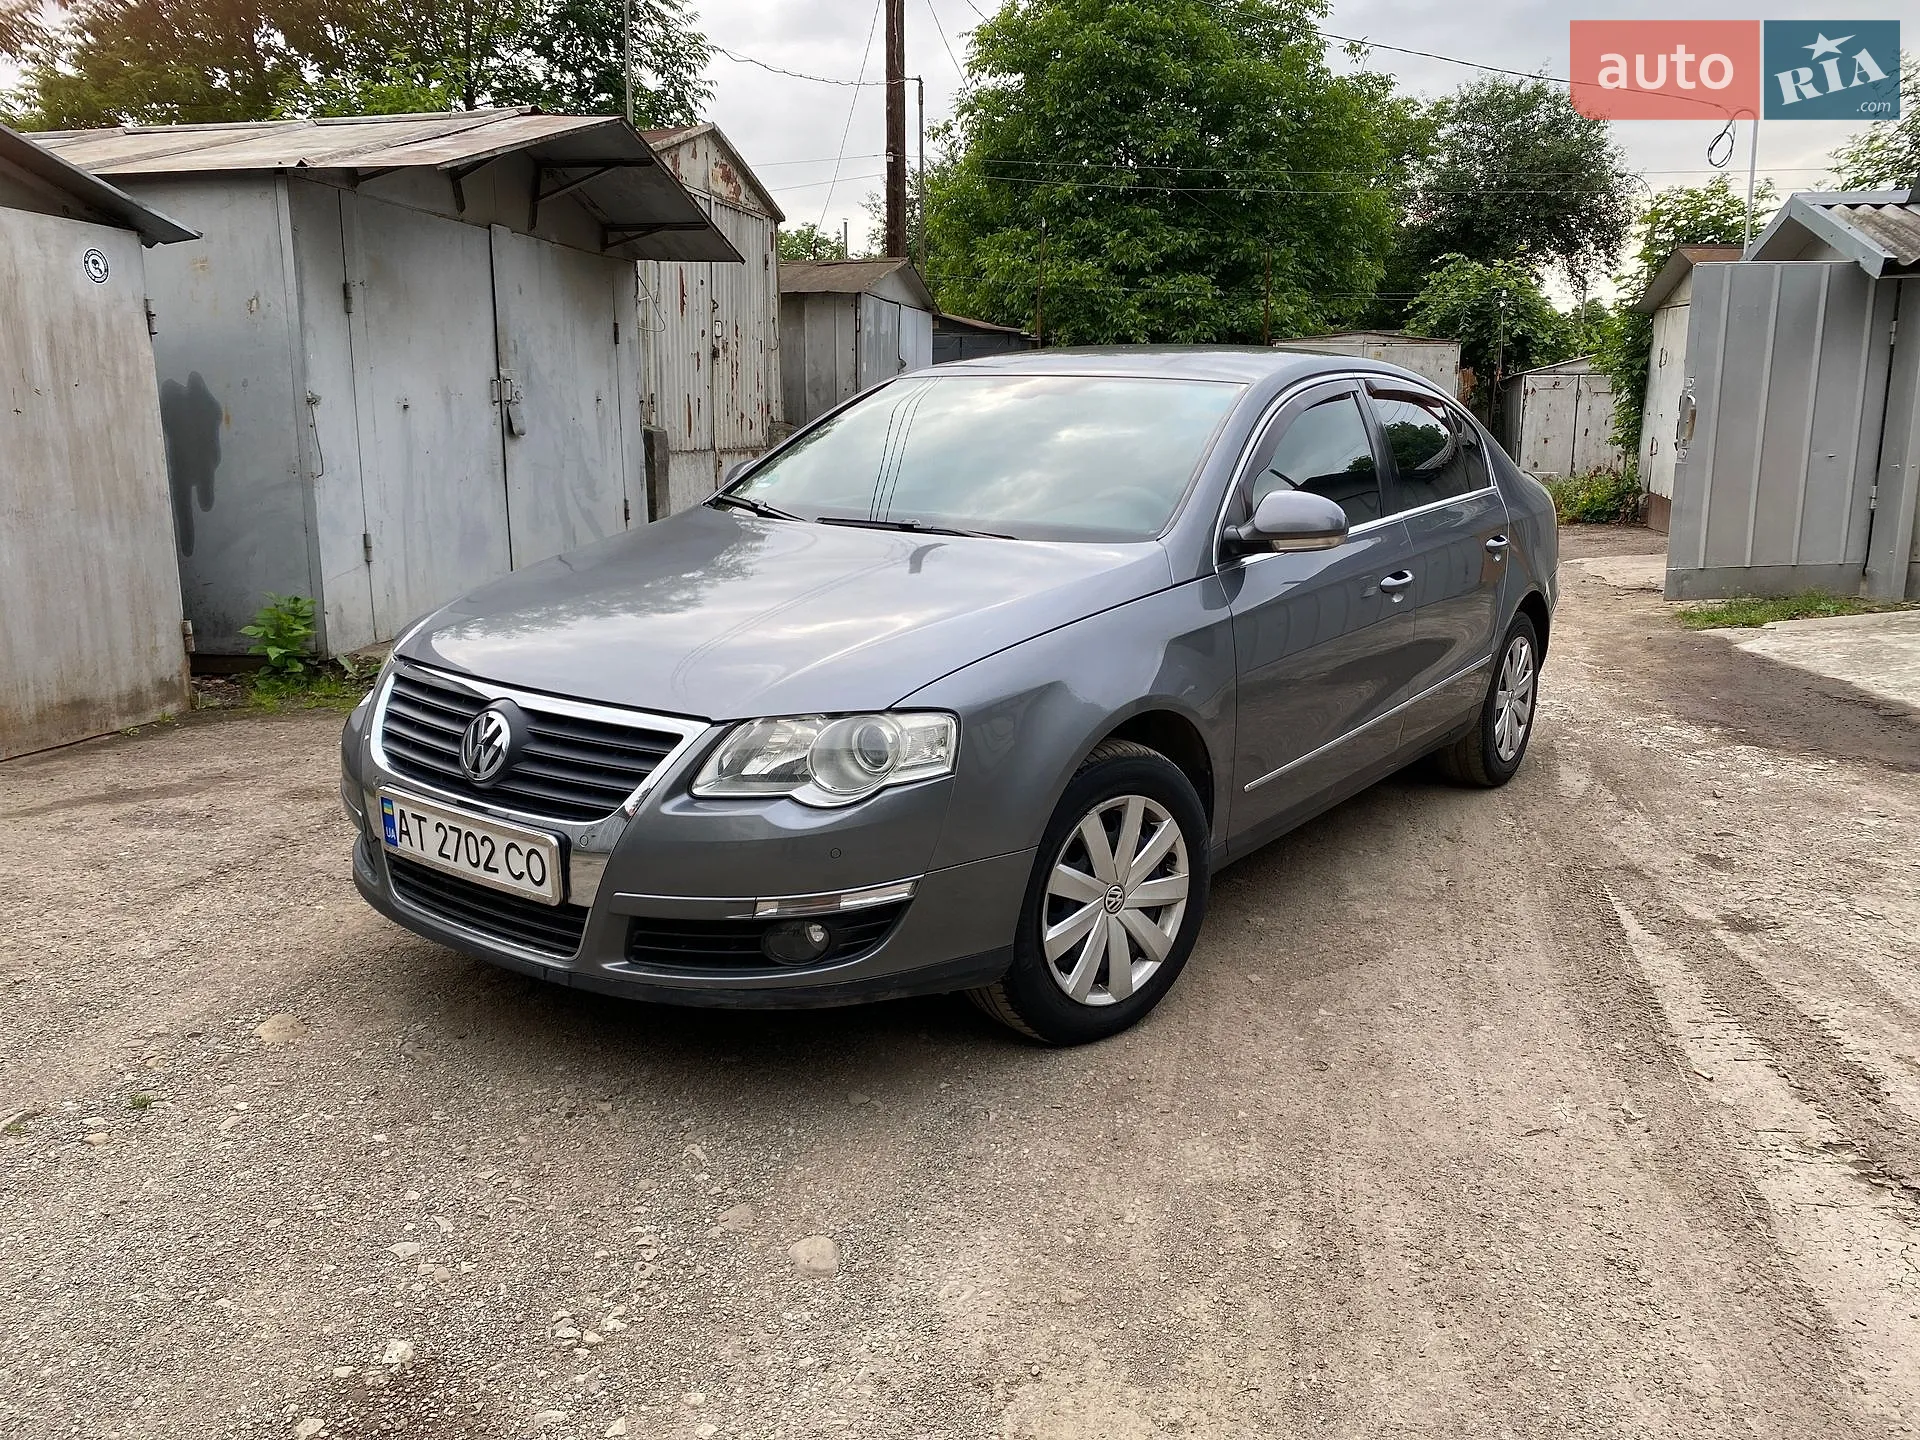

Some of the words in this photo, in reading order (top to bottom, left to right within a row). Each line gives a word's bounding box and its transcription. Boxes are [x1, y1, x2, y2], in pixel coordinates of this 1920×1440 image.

[385, 825, 397, 840] UA
[399, 808, 427, 852] AT
[435, 821, 499, 874] 2702
[504, 842, 546, 887] CO
